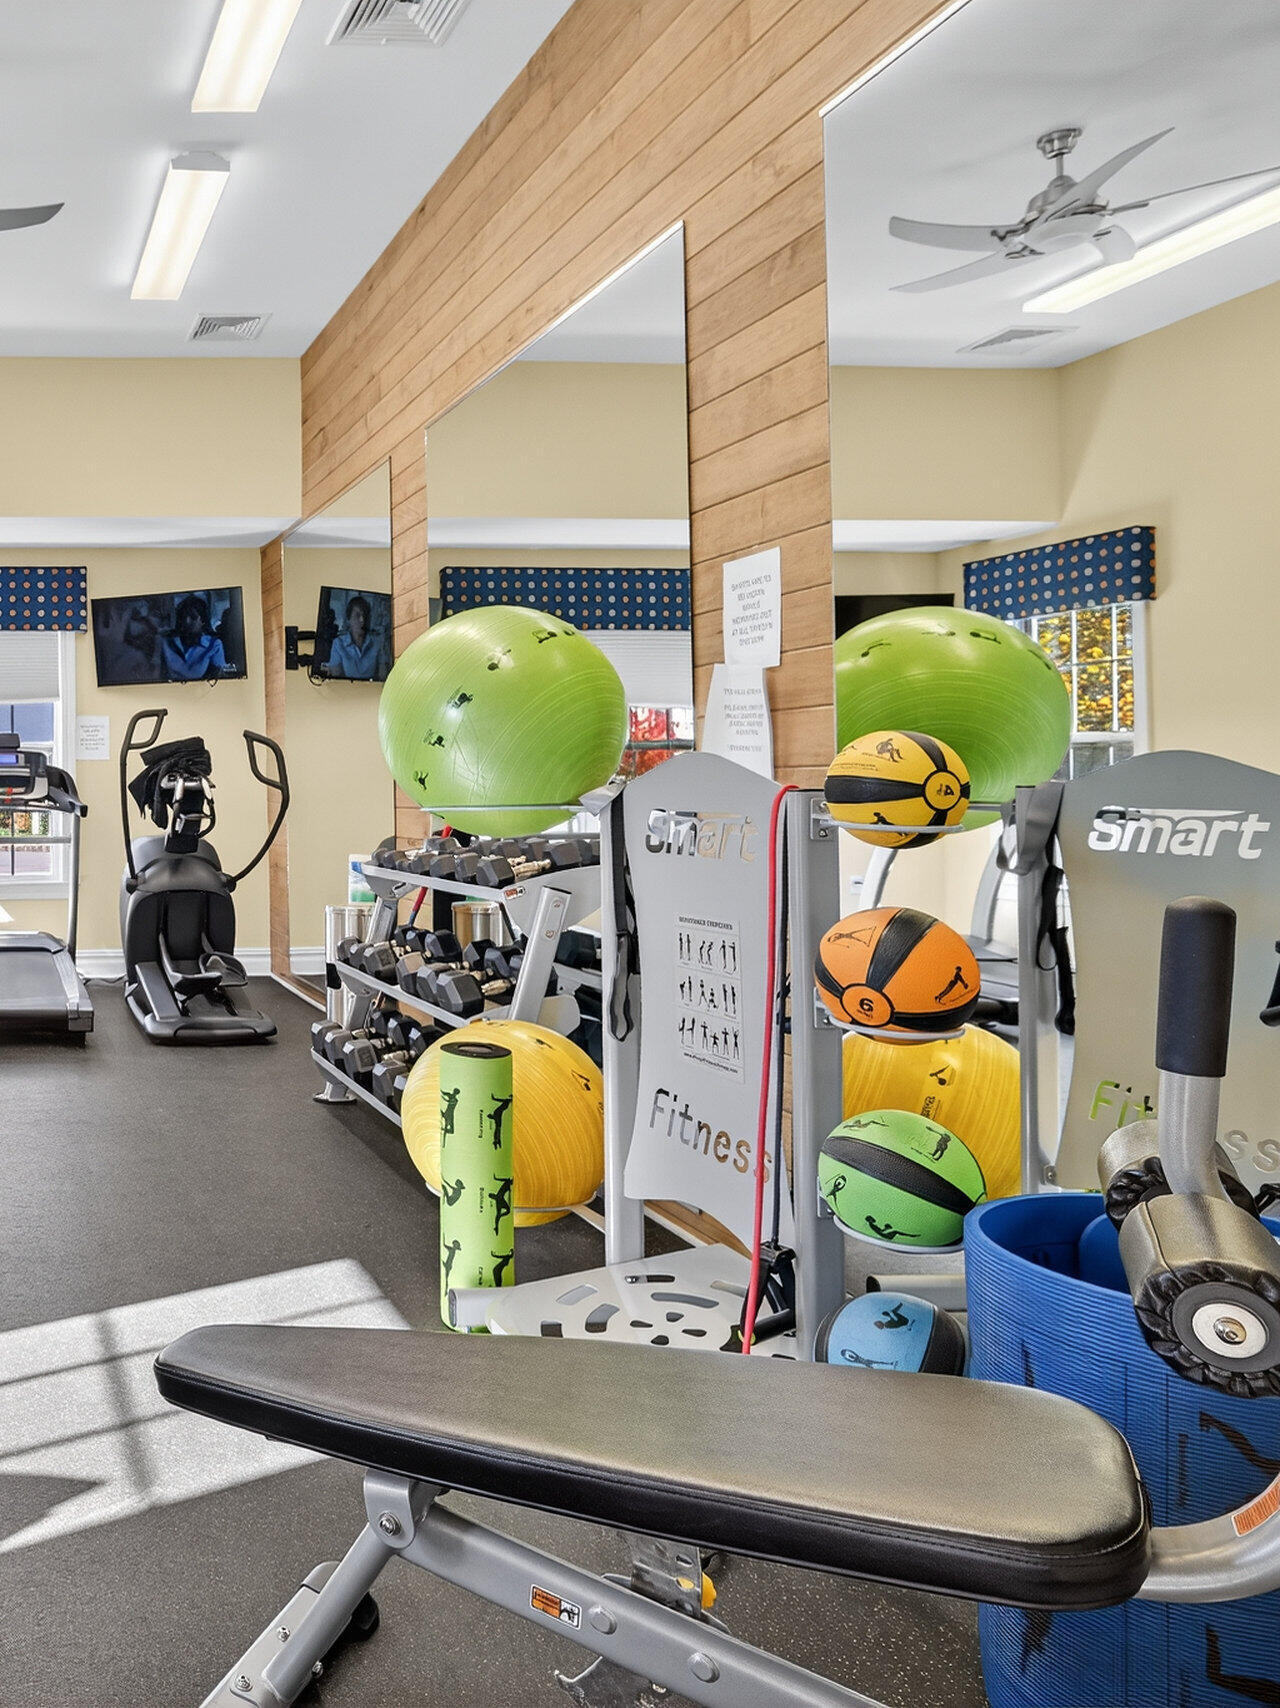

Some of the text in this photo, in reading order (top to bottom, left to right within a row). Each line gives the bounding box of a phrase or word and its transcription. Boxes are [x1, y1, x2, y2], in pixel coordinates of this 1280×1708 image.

[645, 808, 760, 863] Smart
[1087, 806, 1271, 860] Smart
[859, 997, 874, 1012] 6
